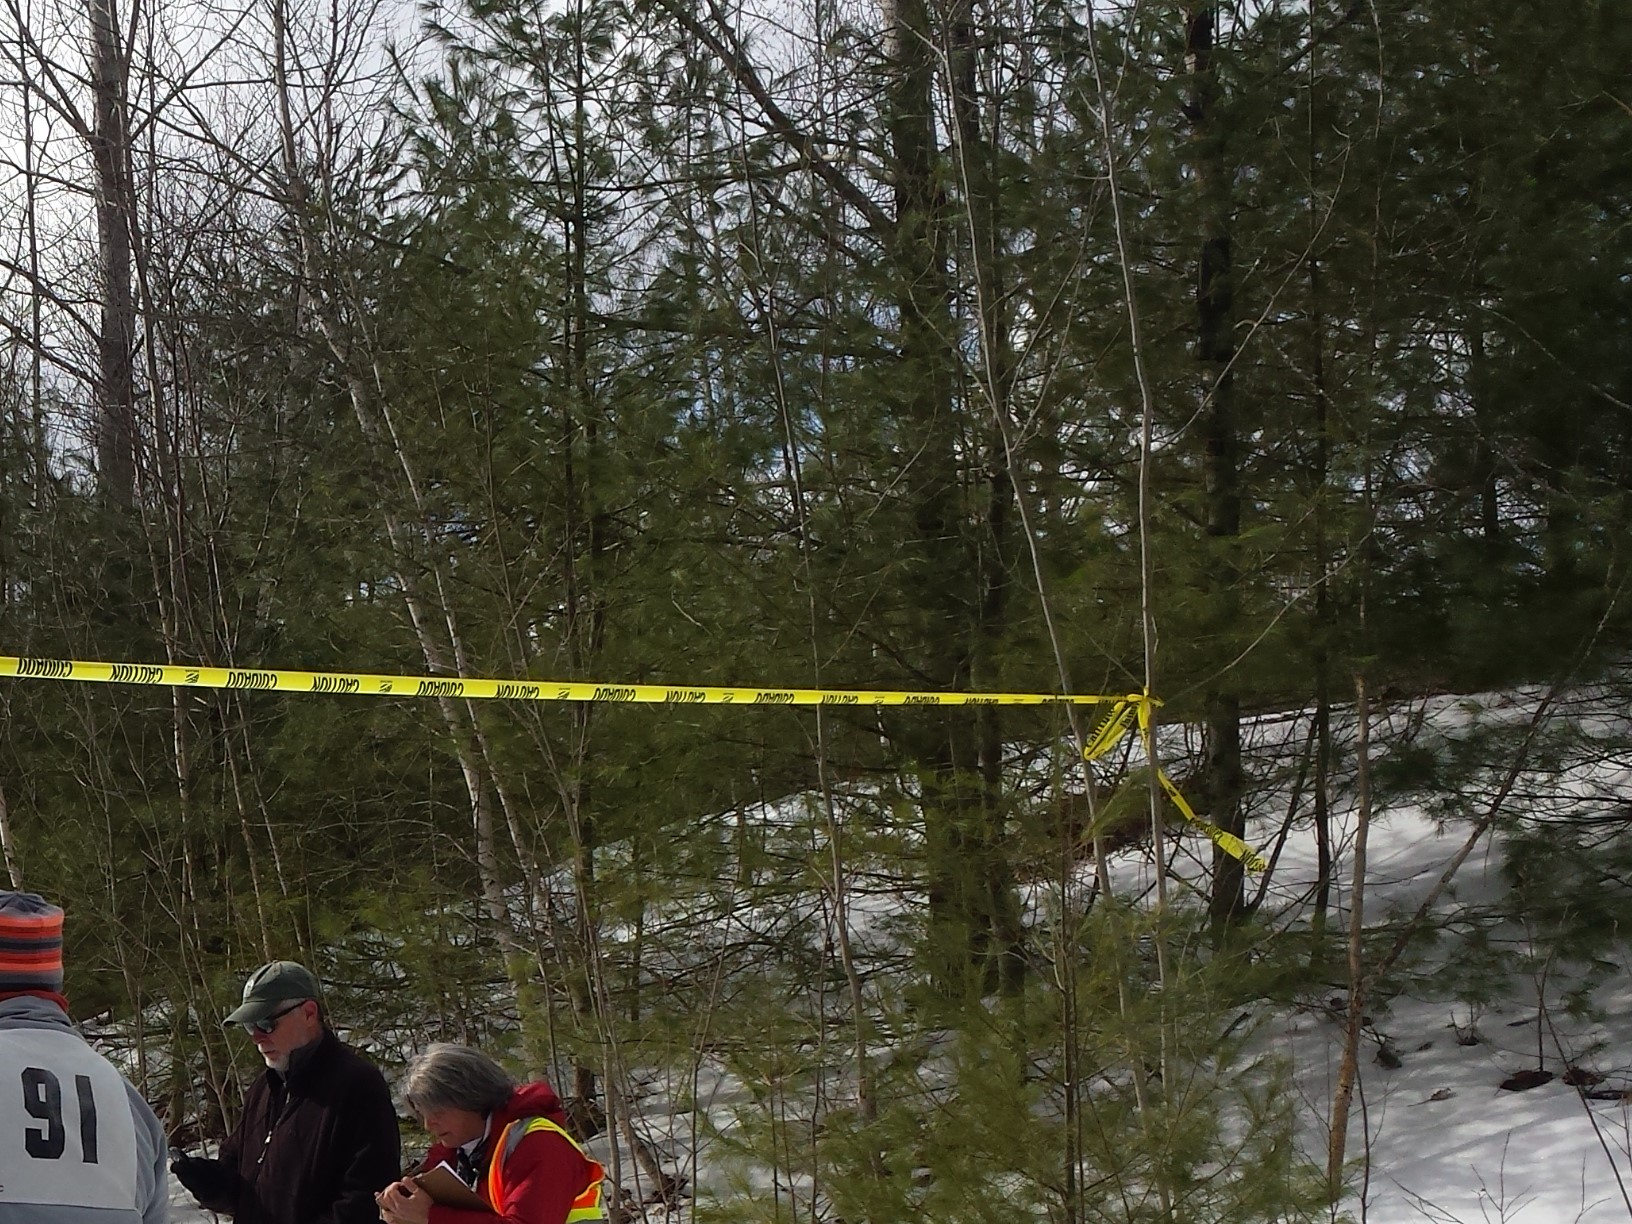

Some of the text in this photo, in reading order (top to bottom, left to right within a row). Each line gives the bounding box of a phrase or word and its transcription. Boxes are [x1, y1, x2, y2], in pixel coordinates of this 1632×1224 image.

[16, 656, 74, 678] CUIDADO
[110, 663, 164, 685] CAUTION
[226, 670, 278, 690] CUIDADO
[312, 675, 361, 694] CAUTION
[418, 679, 465, 697] CUIDADO
[496, 683, 540, 699] CAUTION
[592, 686, 636, 702] CUIDADO
[664, 689, 706, 704] CAUTION
[21, 1066, 98, 1164] 91
